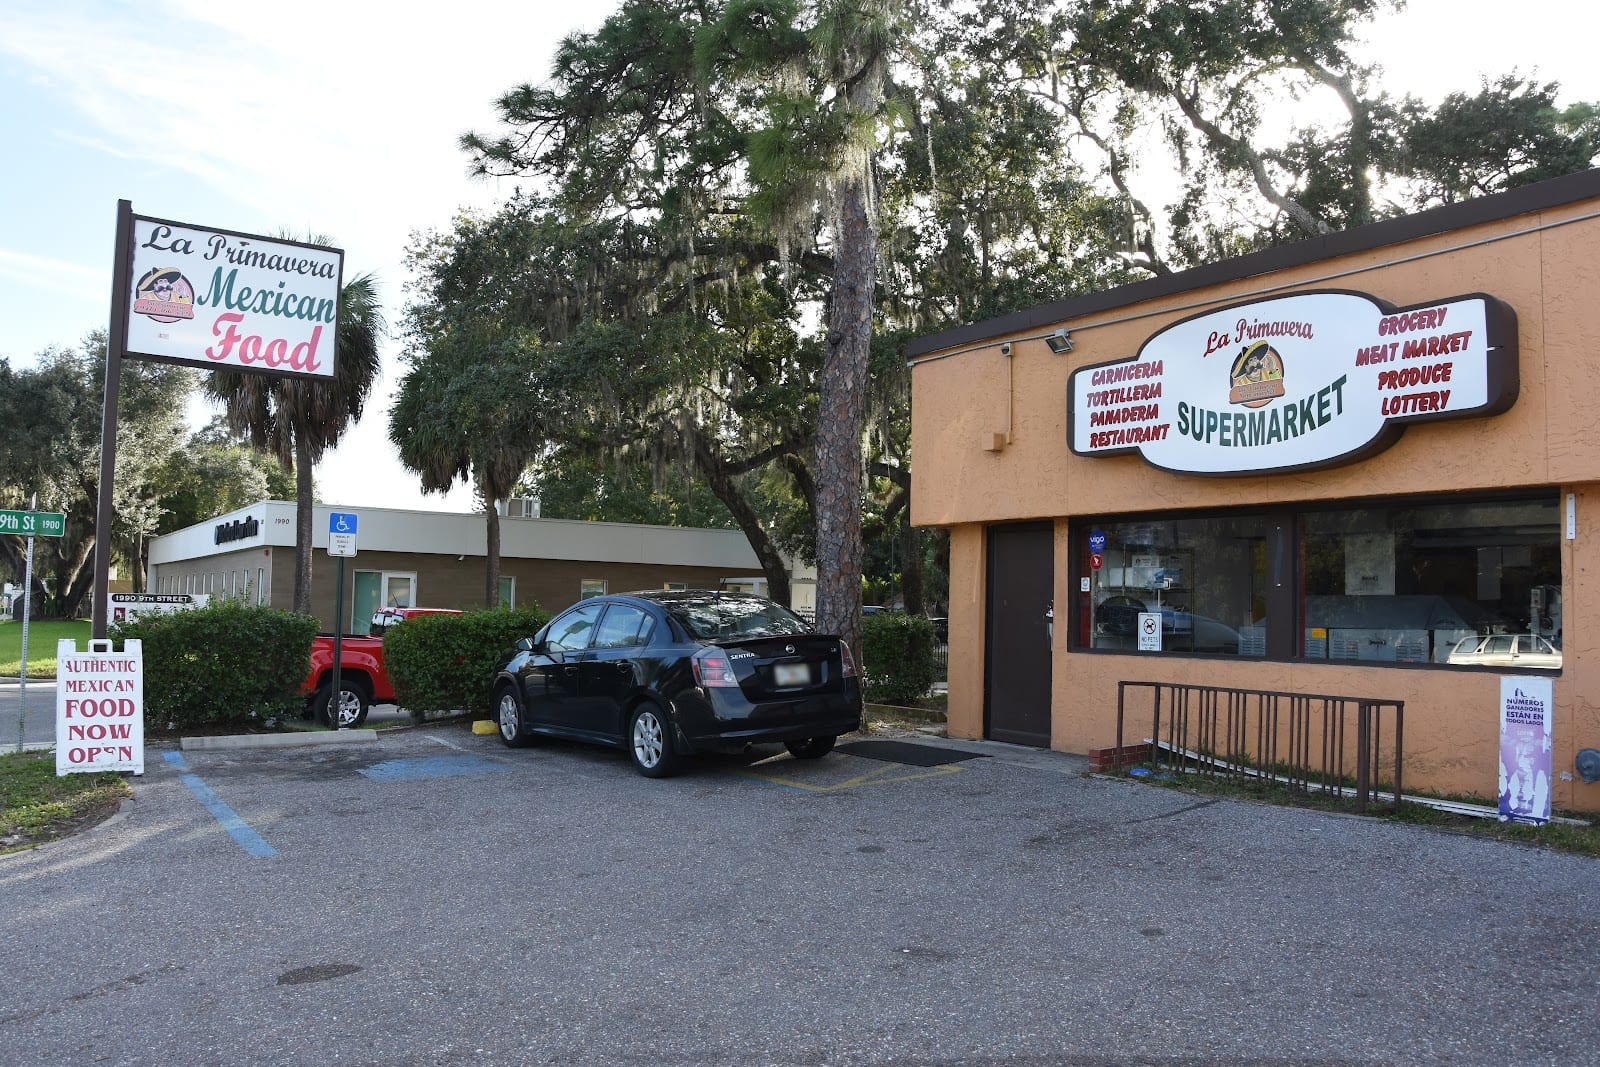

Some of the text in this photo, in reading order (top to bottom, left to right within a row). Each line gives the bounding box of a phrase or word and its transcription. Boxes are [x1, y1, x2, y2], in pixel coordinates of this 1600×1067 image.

[141, 225, 336, 280] La Primavera
[197, 266, 336, 324] Mexican
[1378, 307, 1448, 337] GROCERY
[205, 312, 324, 373] Food
[1203, 318, 1314, 358] La Primavera
[1355, 330, 1473, 367] MEAT MARKET
[1091, 360, 1164, 387] CARNICERIA
[1378, 362, 1453, 391] PRODUCE
[1086, 382, 1162, 408] TORTILLERIA
[1381, 390, 1451, 416] LOTTERY
[1090, 403, 1159, 428] PANADERIA
[1177, 374, 1347, 448] SUPERMARKET
[1089, 424, 1170, 449] RESTAURANT
[0, 514, 60, 530] 9th St 1900
[156, 595, 189, 603] STREET
[65, 660, 136, 673] AUTHENTIC
[730, 652, 756, 660] SENTRA
[65, 679, 134, 693] MEXICAN
[64, 698, 135, 718] FOOD
[68, 723, 133, 741] NOW
